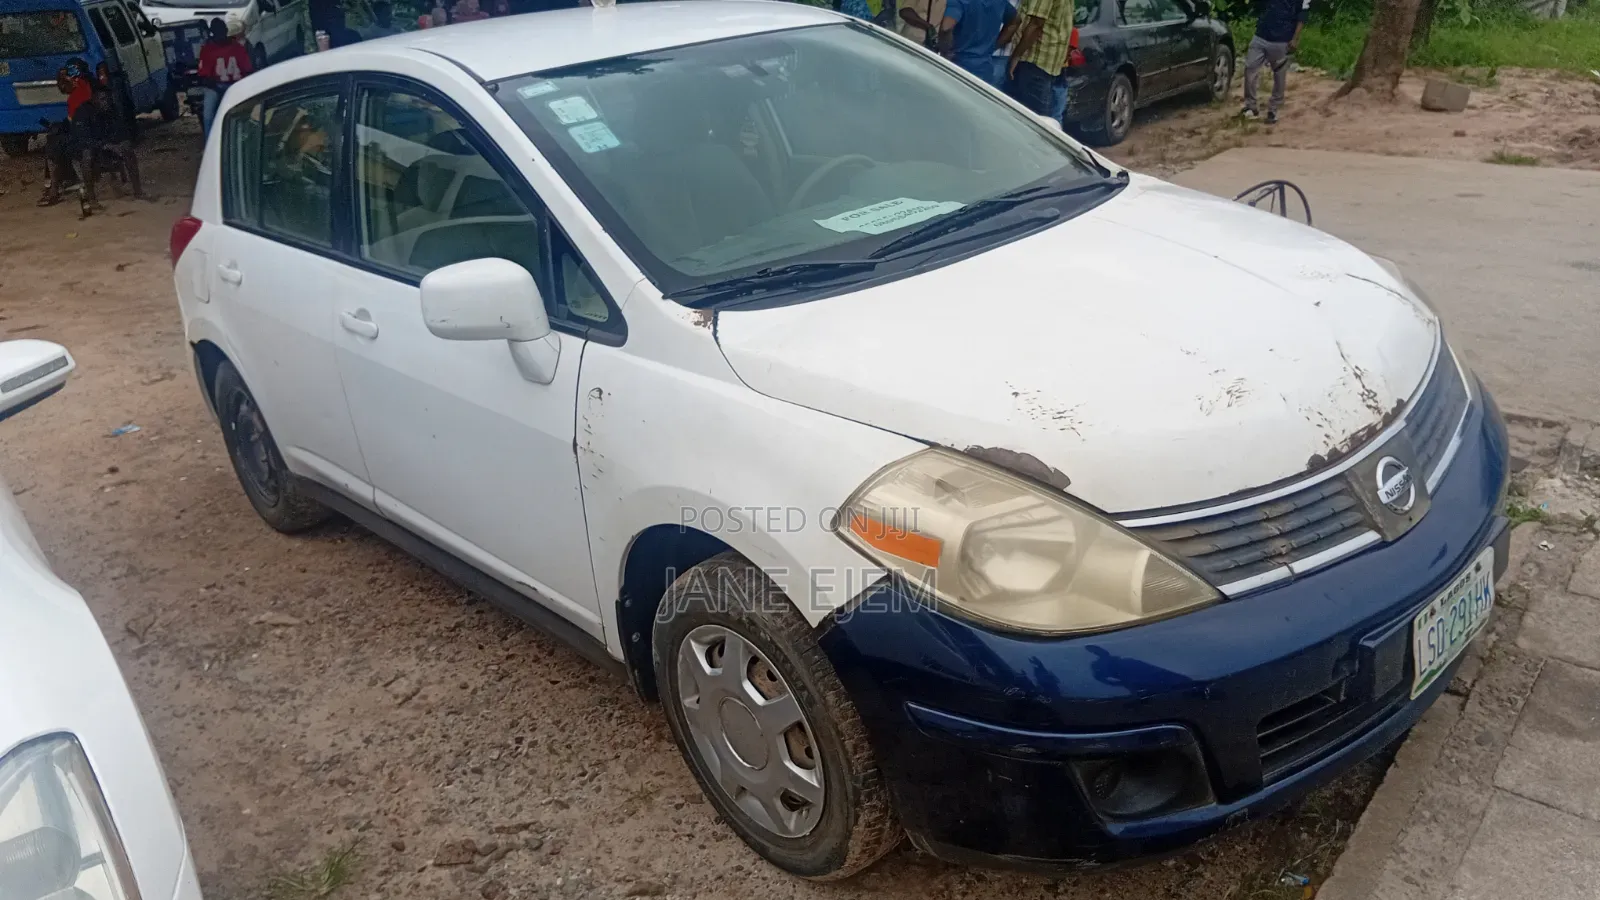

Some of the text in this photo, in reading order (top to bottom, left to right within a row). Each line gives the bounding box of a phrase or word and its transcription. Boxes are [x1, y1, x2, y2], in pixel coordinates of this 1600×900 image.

[216, 56, 241, 81] 44
[842, 209, 869, 221] FOR
[871, 200, 904, 213] SALE
[1385, 474, 1412, 499] NISS
[1440, 572, 1471, 607] LAGOS
